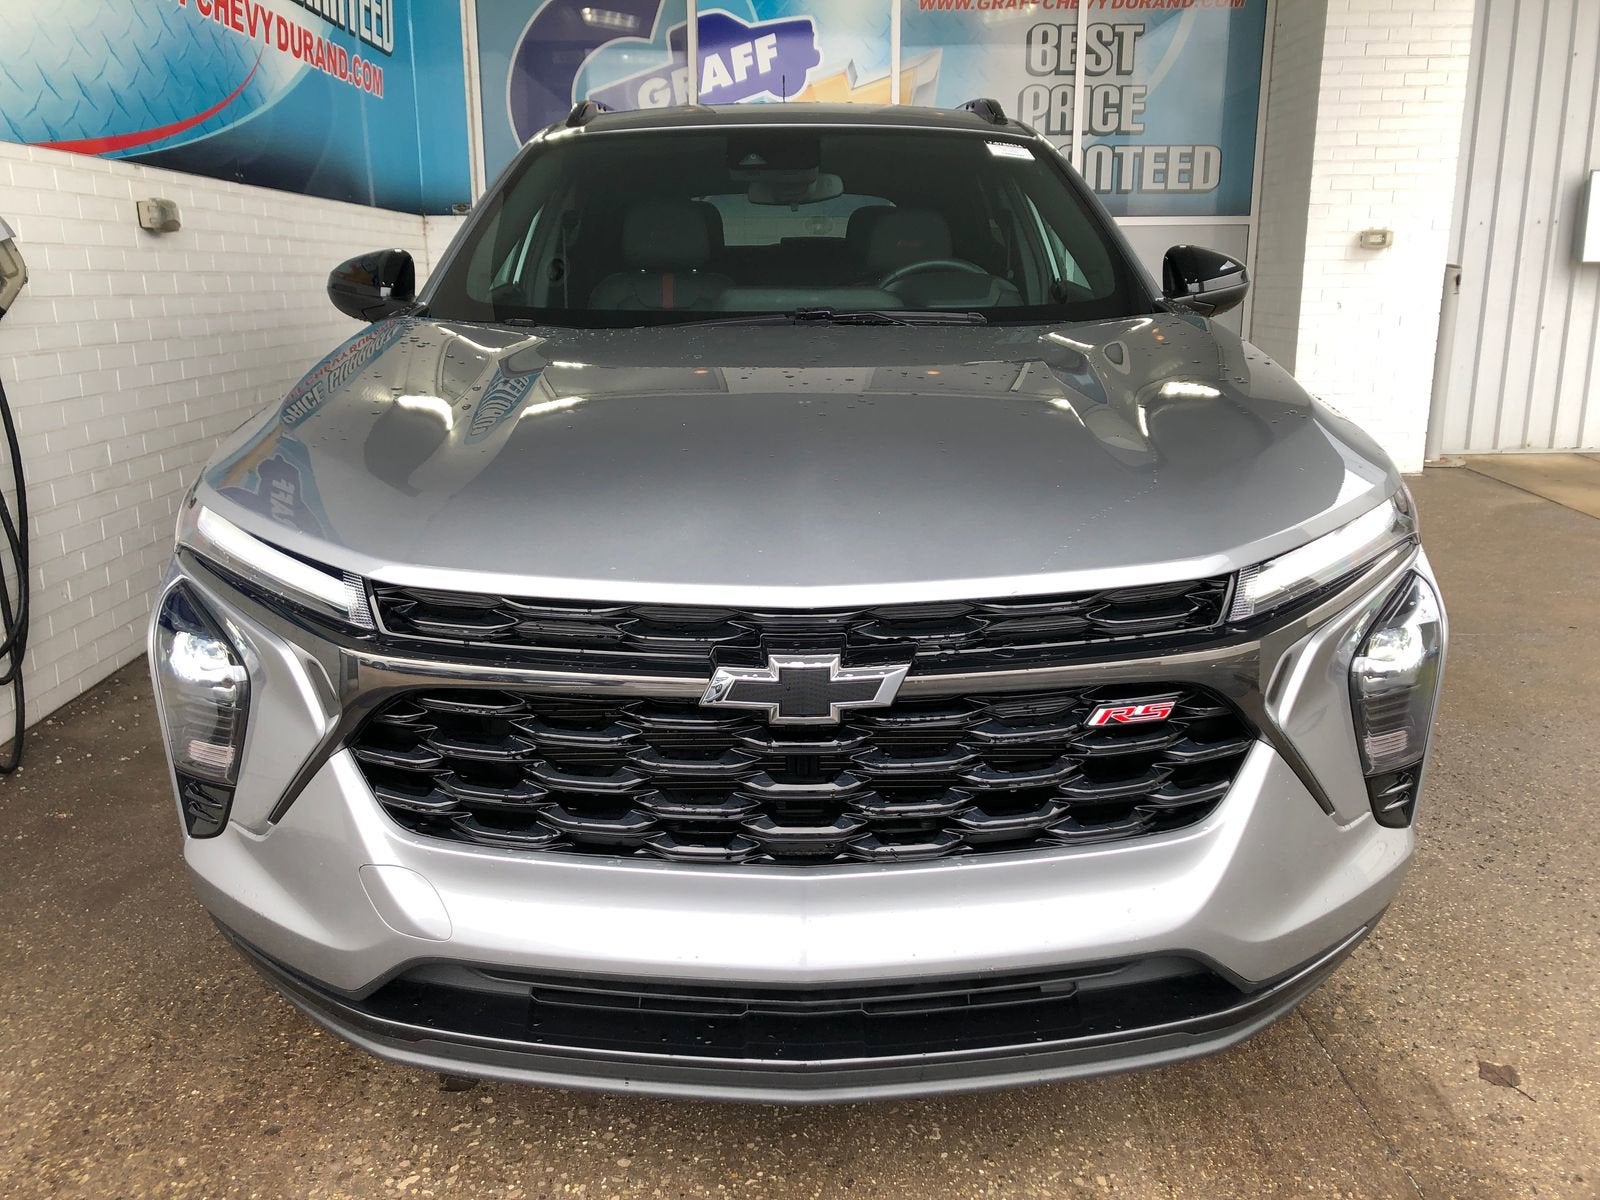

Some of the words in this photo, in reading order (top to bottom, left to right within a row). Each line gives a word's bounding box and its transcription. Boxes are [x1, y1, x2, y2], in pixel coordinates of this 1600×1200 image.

[1026, 22, 1146, 77] BEST
[1017, 84, 1148, 136] PRICE
[1060, 144, 1222, 194] NTEED
[1088, 701, 1177, 726] RS
